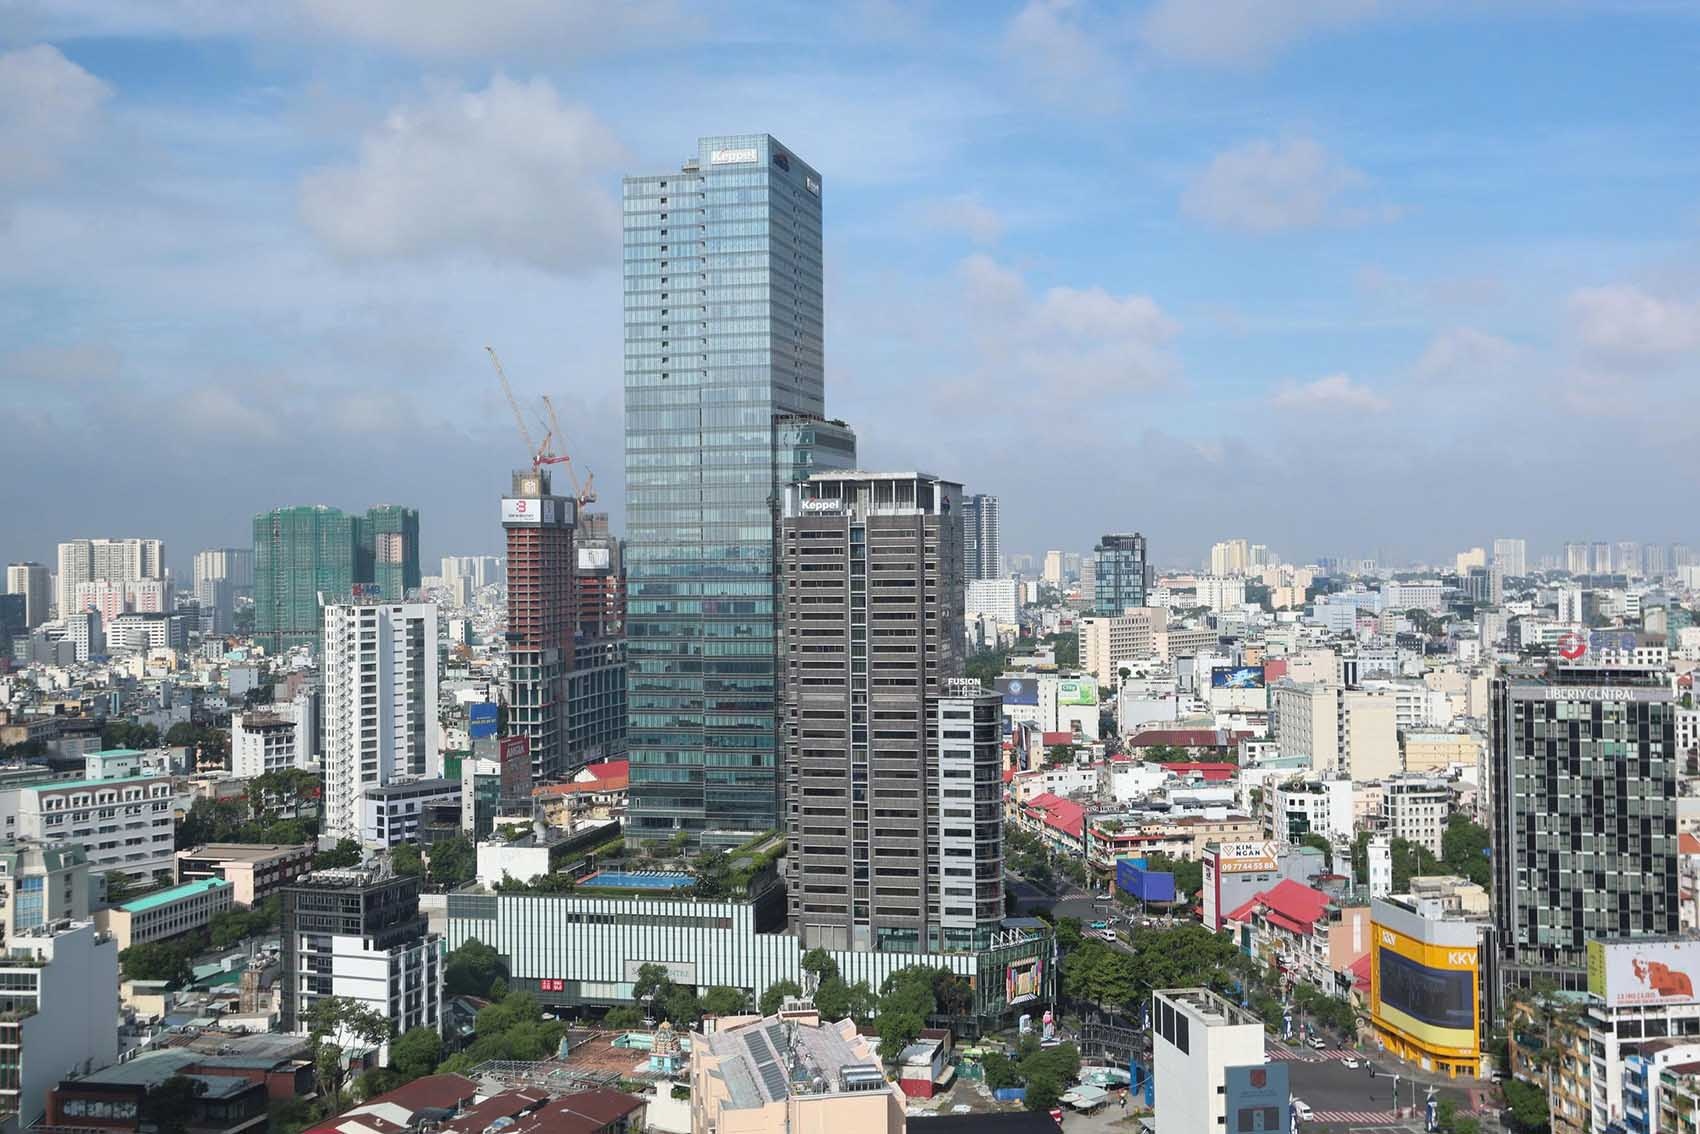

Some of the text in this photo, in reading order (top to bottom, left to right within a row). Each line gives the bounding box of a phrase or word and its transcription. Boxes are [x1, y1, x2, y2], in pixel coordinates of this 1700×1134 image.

[801, 500, 839, 511] Keppel
[1545, 688, 1586, 700] LIBERTY
[1447, 951, 1476, 965] KKV
